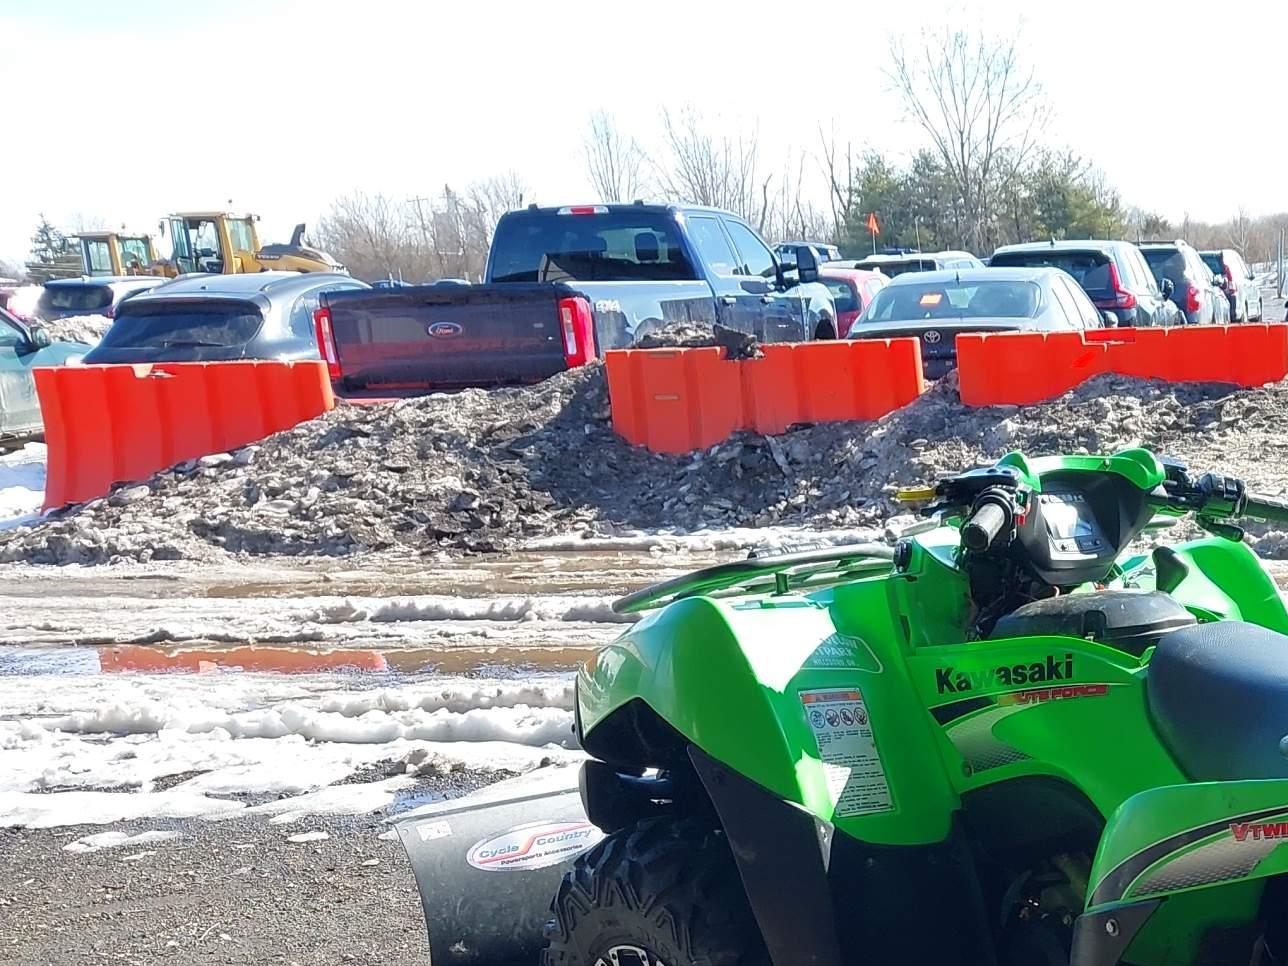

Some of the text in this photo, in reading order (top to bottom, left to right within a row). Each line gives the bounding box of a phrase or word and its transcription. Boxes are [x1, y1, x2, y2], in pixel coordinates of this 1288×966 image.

[935, 654, 1073, 694] Kawasaki
[479, 828, 592, 859] Cycle Country
[500, 843, 583, 866] Powersports Accessories
